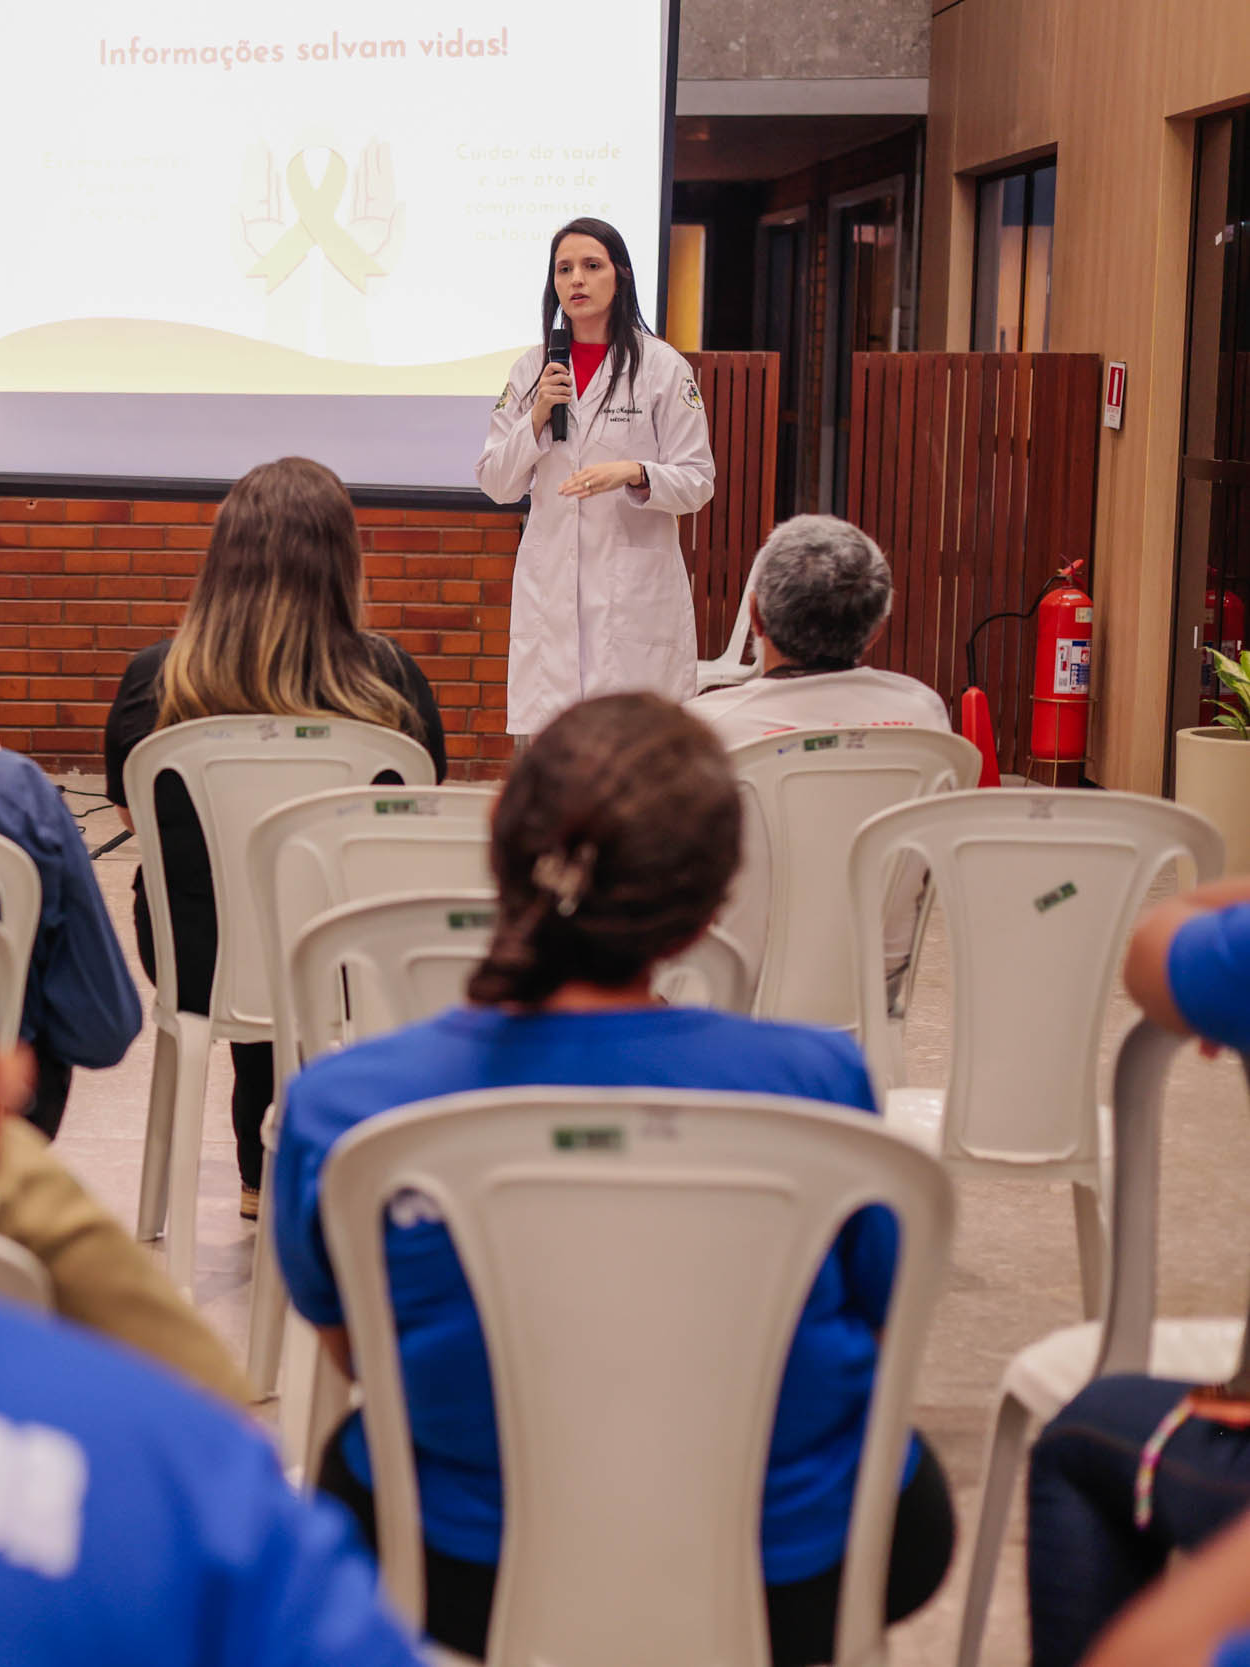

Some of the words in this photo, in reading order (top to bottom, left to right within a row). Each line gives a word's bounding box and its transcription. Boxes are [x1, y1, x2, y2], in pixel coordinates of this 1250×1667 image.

[100, 35, 285, 71] Informações
[296, 30, 407, 61] salvam
[418, 26, 509, 57] vidas!
